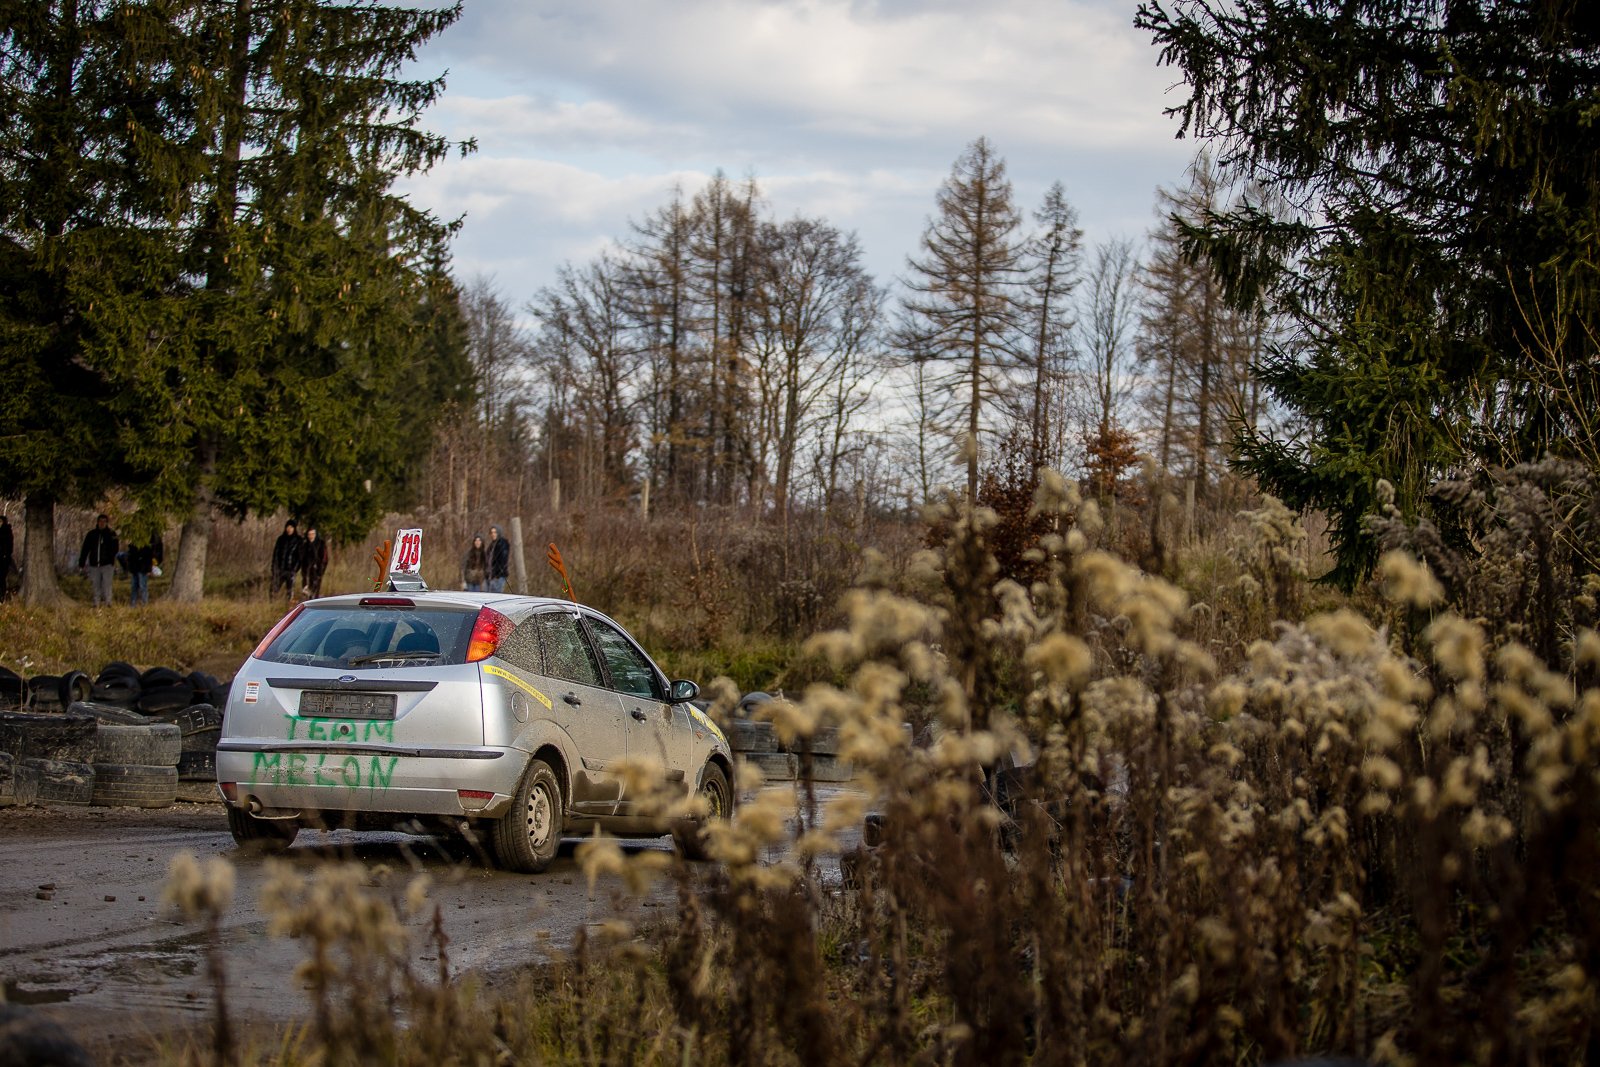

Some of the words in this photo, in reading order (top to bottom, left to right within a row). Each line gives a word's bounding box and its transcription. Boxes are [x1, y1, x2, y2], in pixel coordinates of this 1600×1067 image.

[398, 533, 420, 565] 113
[284, 715, 394, 742] TEAM
[251, 752, 398, 790] MELON
